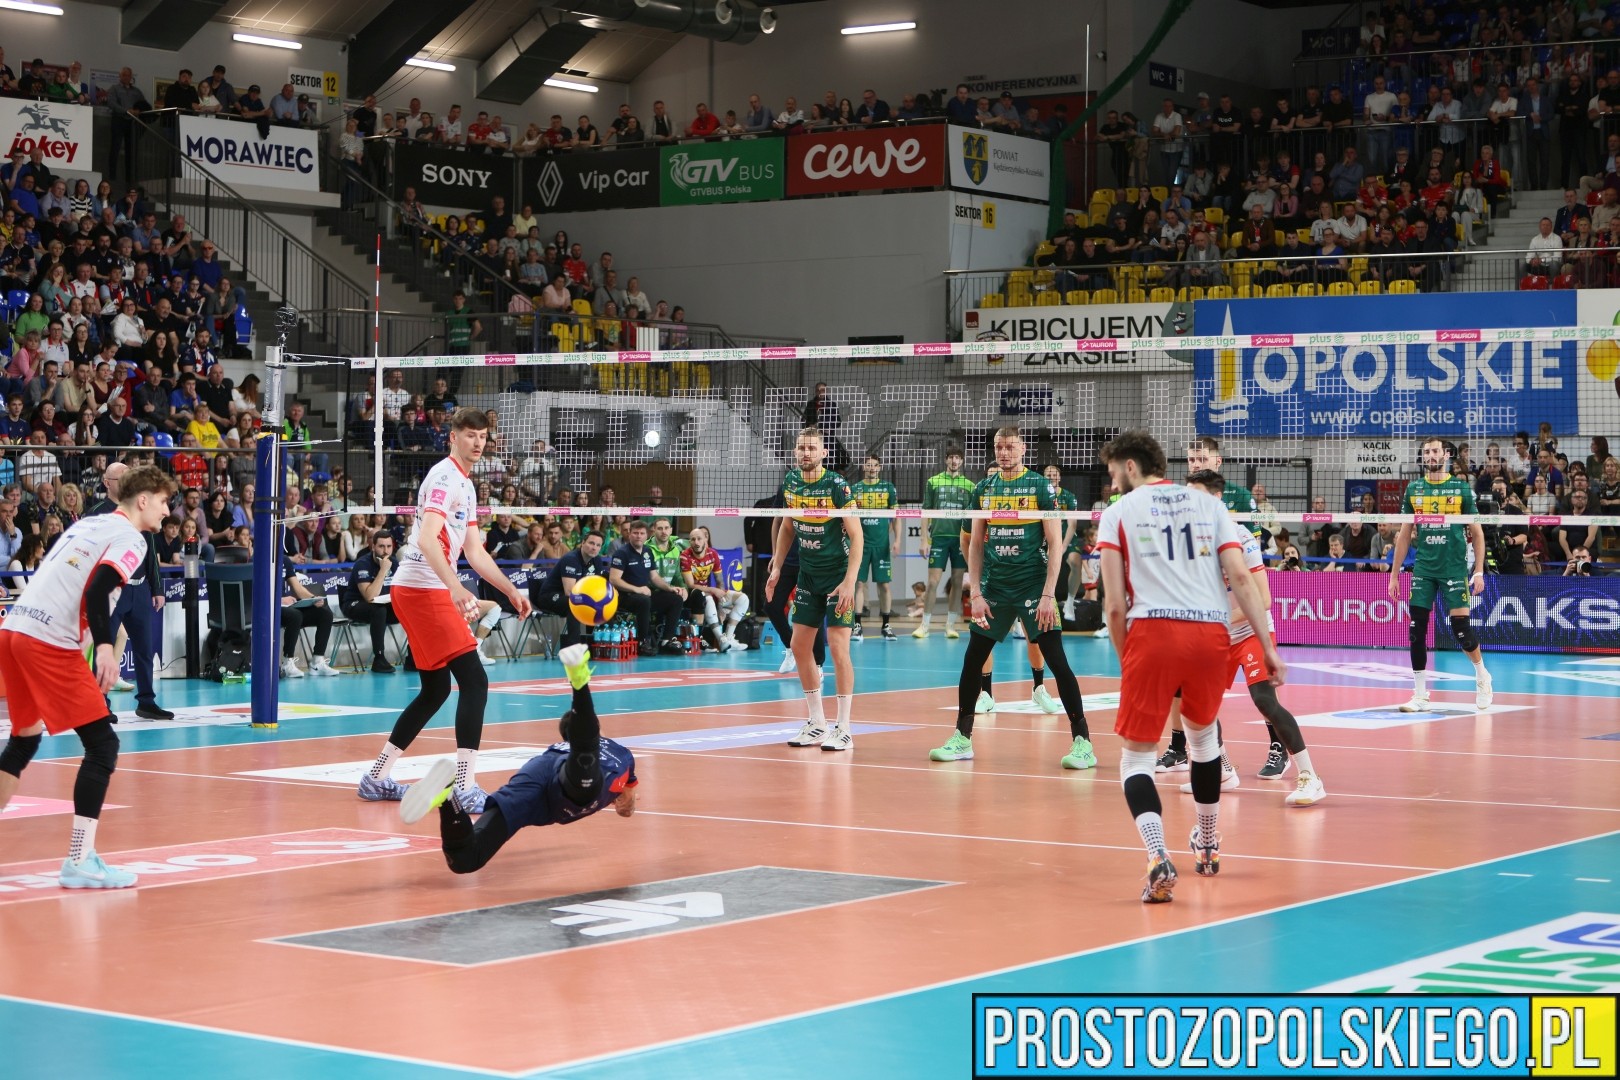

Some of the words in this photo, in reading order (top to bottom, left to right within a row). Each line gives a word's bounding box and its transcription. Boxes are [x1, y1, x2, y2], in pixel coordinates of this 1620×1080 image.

[1152, 69, 1165, 81] WC
[290, 73, 322, 89] SEKTOR
[325, 77, 336, 92] 12
[968, 75, 1078, 93] KONFERENCYJNA
[4, 133, 79, 163] jokey
[186, 134, 314, 174] MORAWIEC
[803, 138, 926, 180] cewe
[993, 148, 1018, 162] POWIAT
[422, 163, 492, 188] SONY
[683, 157, 739, 184] GTV
[739, 163, 774, 181] BUS
[579, 170, 610, 193] Vip
[613, 169, 649, 187] Car
[690, 186, 723, 197] GTVBUS
[725, 185, 752, 194] Polska
[955, 204, 981, 221] SEKTOR
[984, 207, 993, 224] 16
[1361, 333, 1383, 344] plus
[1399, 332, 1420, 342] liga
[1498, 329, 1521, 340] plus
[1552, 326, 1576, 338] plus
[1592, 326, 1615, 338] liga
[1132, 339, 1152, 350] plus
[1180, 337, 1201, 348] plus
[1216, 336, 1236, 346] liga
[1310, 334, 1331, 344] plus
[965, 342, 984, 352] plus
[1010, 342, 1031, 352] plus
[1253, 341, 1563, 394] OPOLSKIE
[1363, 442, 1391, 453] KĄCIK
[1357, 454, 1397, 463] MAŁEGO
[1362, 467, 1392, 475] KIBICA
[1432, 501, 1438, 514] 3
[1474, 516, 1490, 524] plus
[799, 524, 824, 534] aluron
[997, 528, 1024, 536] aluron
[1162, 523, 1194, 560] 11
[1426, 536, 1446, 544] CMC
[1274, 597, 1409, 622] TAURON
